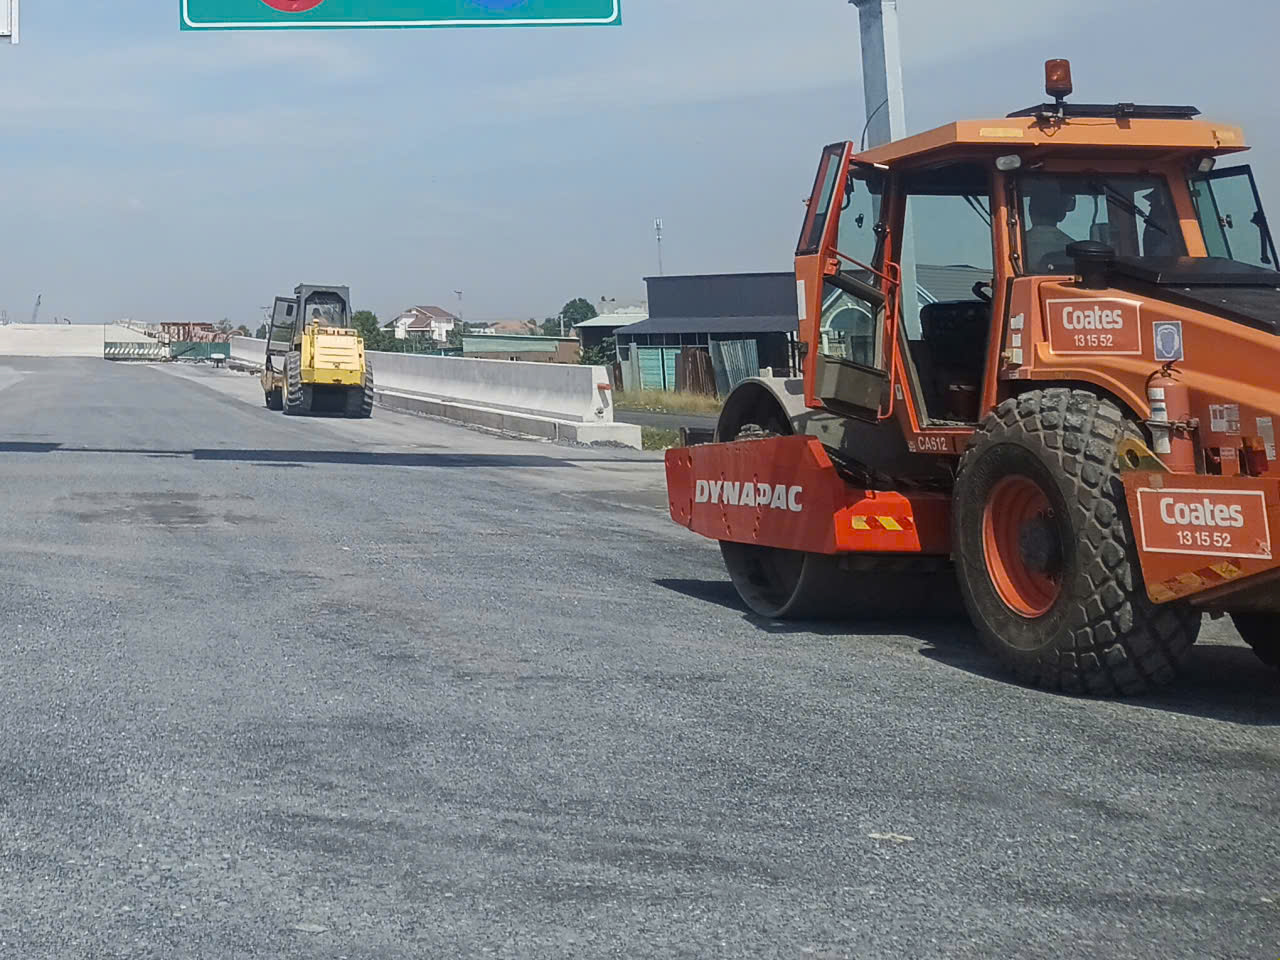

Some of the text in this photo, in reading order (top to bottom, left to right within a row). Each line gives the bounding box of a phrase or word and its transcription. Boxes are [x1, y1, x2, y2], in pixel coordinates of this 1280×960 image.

[1062, 306, 1123, 330] Coates
[1073, 335, 1113, 347] 13 15 52
[695, 480, 803, 512] DYNAPAC
[1160, 497, 1244, 528] Coates
[1177, 531, 1232, 547] 13 15 52
